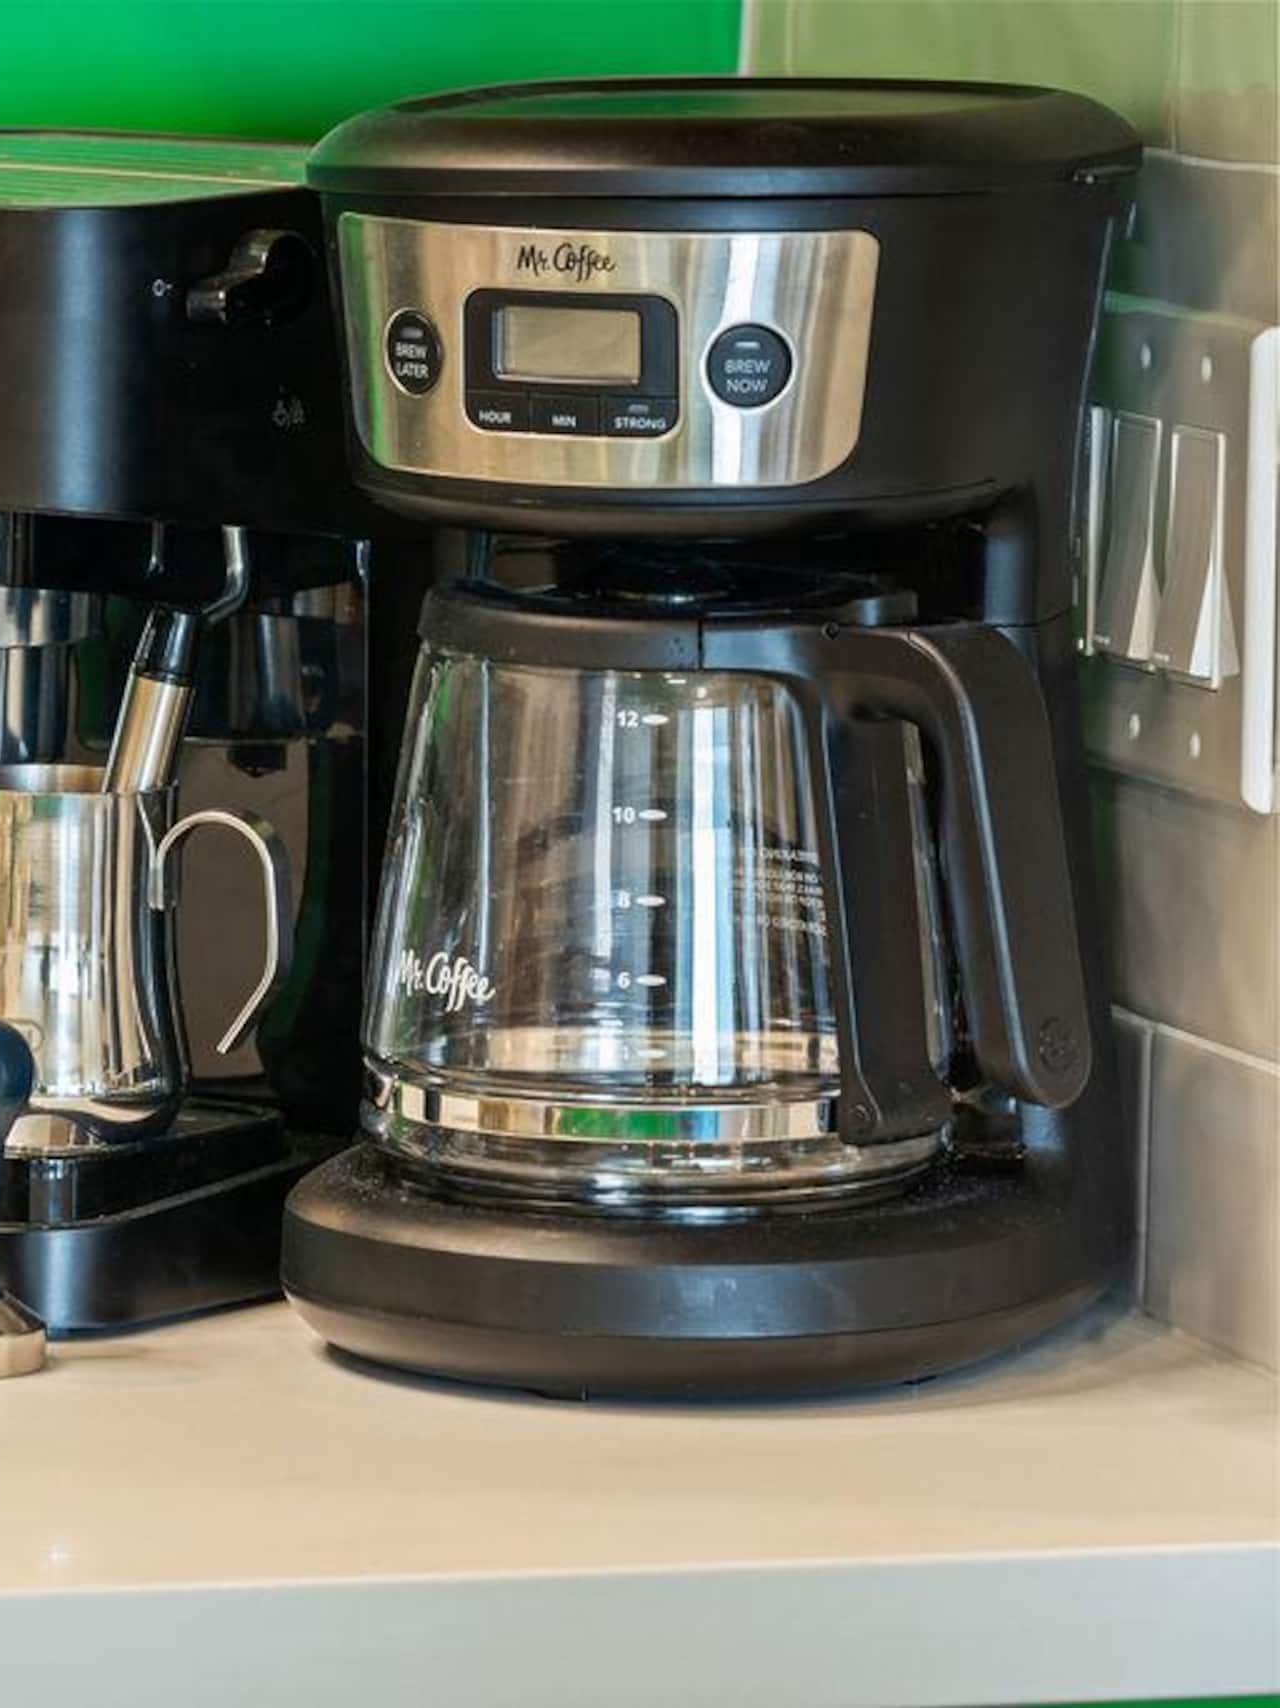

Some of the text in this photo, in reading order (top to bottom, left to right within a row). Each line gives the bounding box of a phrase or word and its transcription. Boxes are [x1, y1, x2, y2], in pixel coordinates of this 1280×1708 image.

[517, 241, 617, 283] Mr. Coffee
[395, 341, 429, 359] BREW
[395, 361, 430, 379] LATER
[724, 358, 772, 375] BREW
[726, 378, 769, 394] NOW
[478, 408, 513, 424] HOUR
[551, 414, 578, 428] MIN
[613, 415, 667, 430] STRONG
[617, 709, 640, 728] 12
[613, 805, 636, 824] 10
[426, 951, 497, 1013] Coffee
[617, 971, 631, 990] 6
